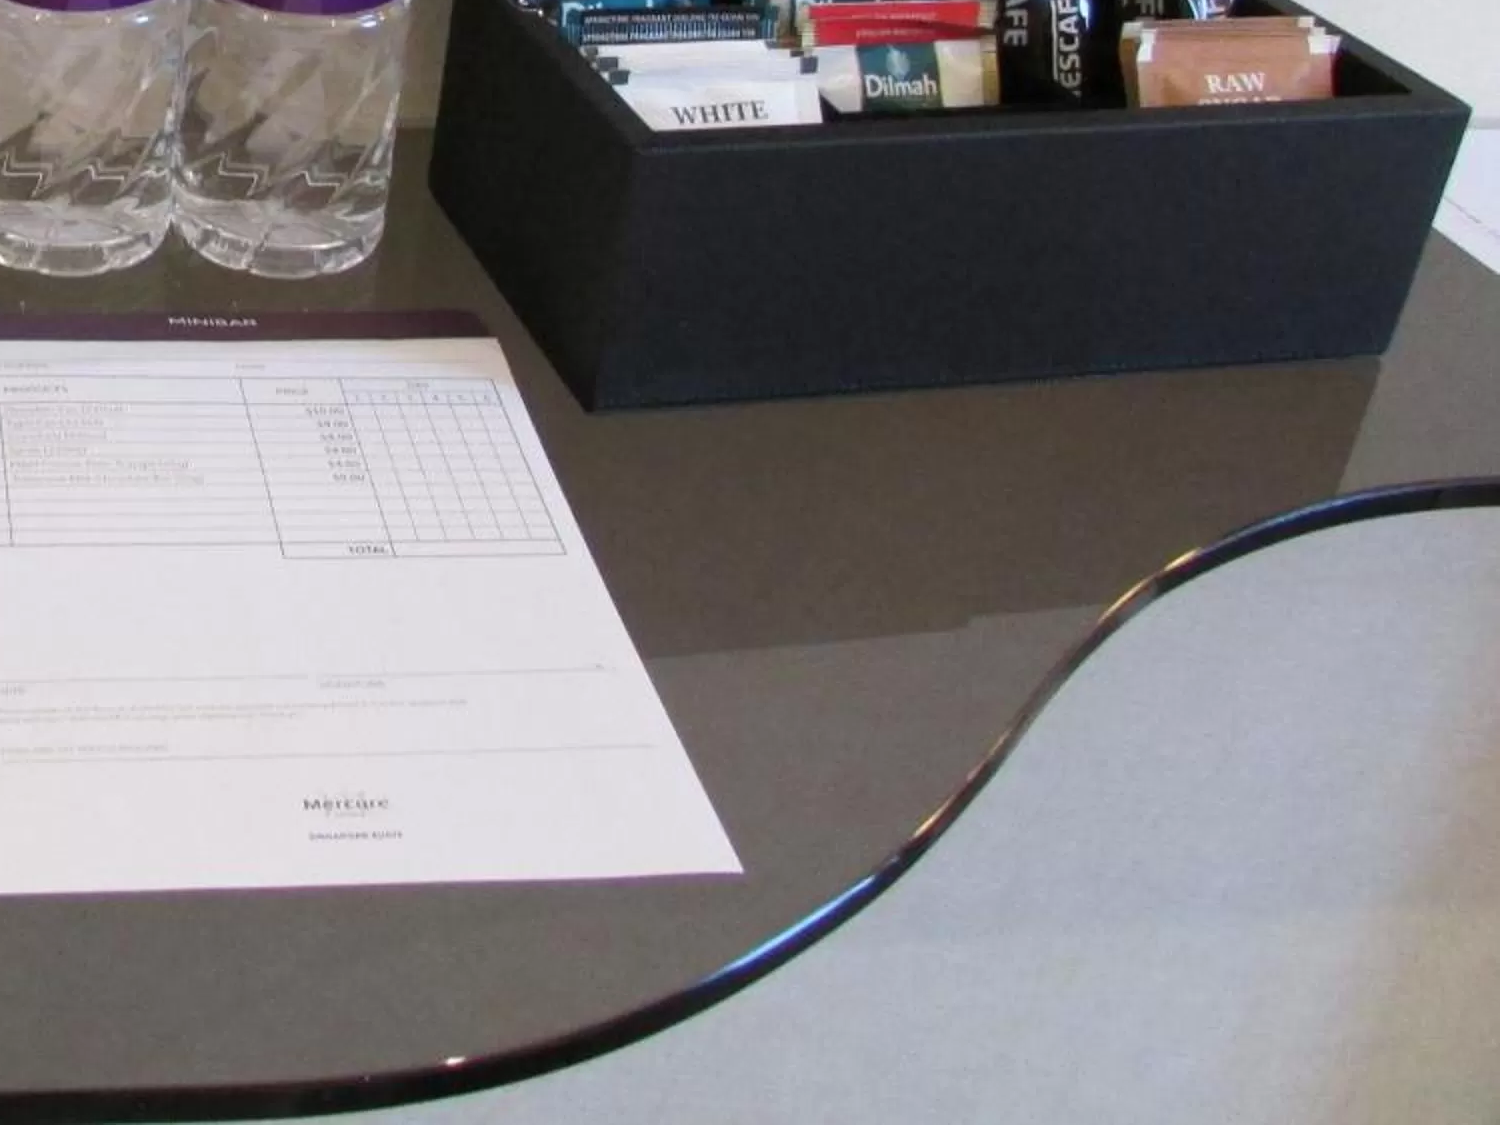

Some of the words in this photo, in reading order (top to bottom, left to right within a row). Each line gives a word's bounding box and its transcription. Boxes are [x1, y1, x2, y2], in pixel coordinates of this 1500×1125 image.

[864, 73, 939, 99] Dilmah
[1203, 71, 1266, 94] RAW
[671, 99, 769, 125] WHITE
[167, 316, 258, 328] MINIBAR
[302, 797, 389, 812] Mercure
